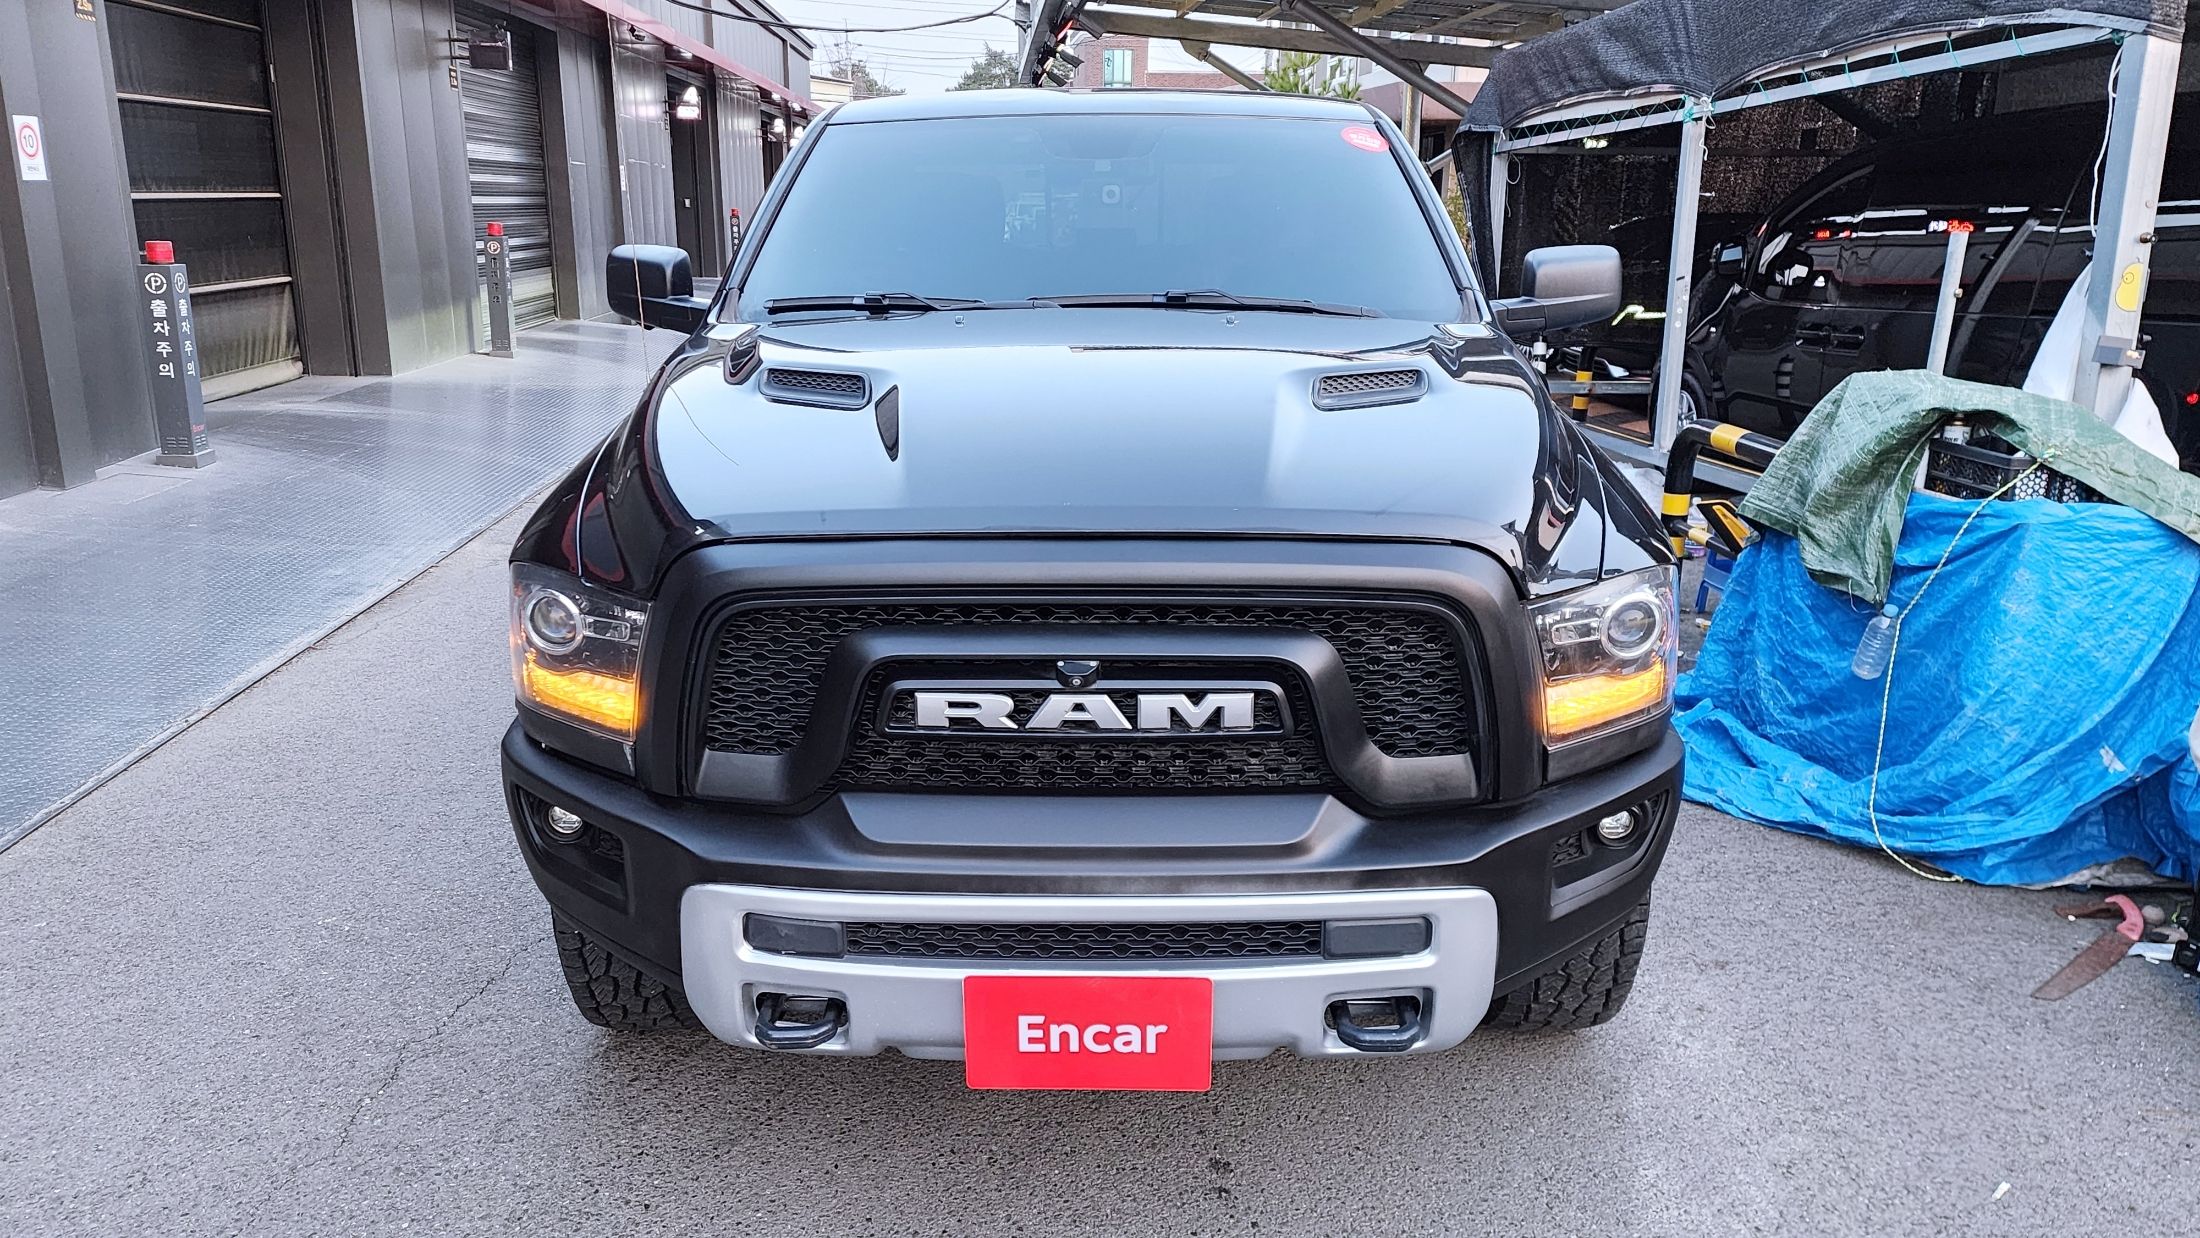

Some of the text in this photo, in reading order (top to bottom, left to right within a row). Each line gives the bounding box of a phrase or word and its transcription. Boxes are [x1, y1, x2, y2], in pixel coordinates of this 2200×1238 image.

[24, 135, 34, 149] 10
[150, 299, 175, 378] 출차주의
[179, 299, 195, 376] 출차주의
[914, 692, 1254, 730] RAM
[1018, 1015, 1168, 1054] Encar
